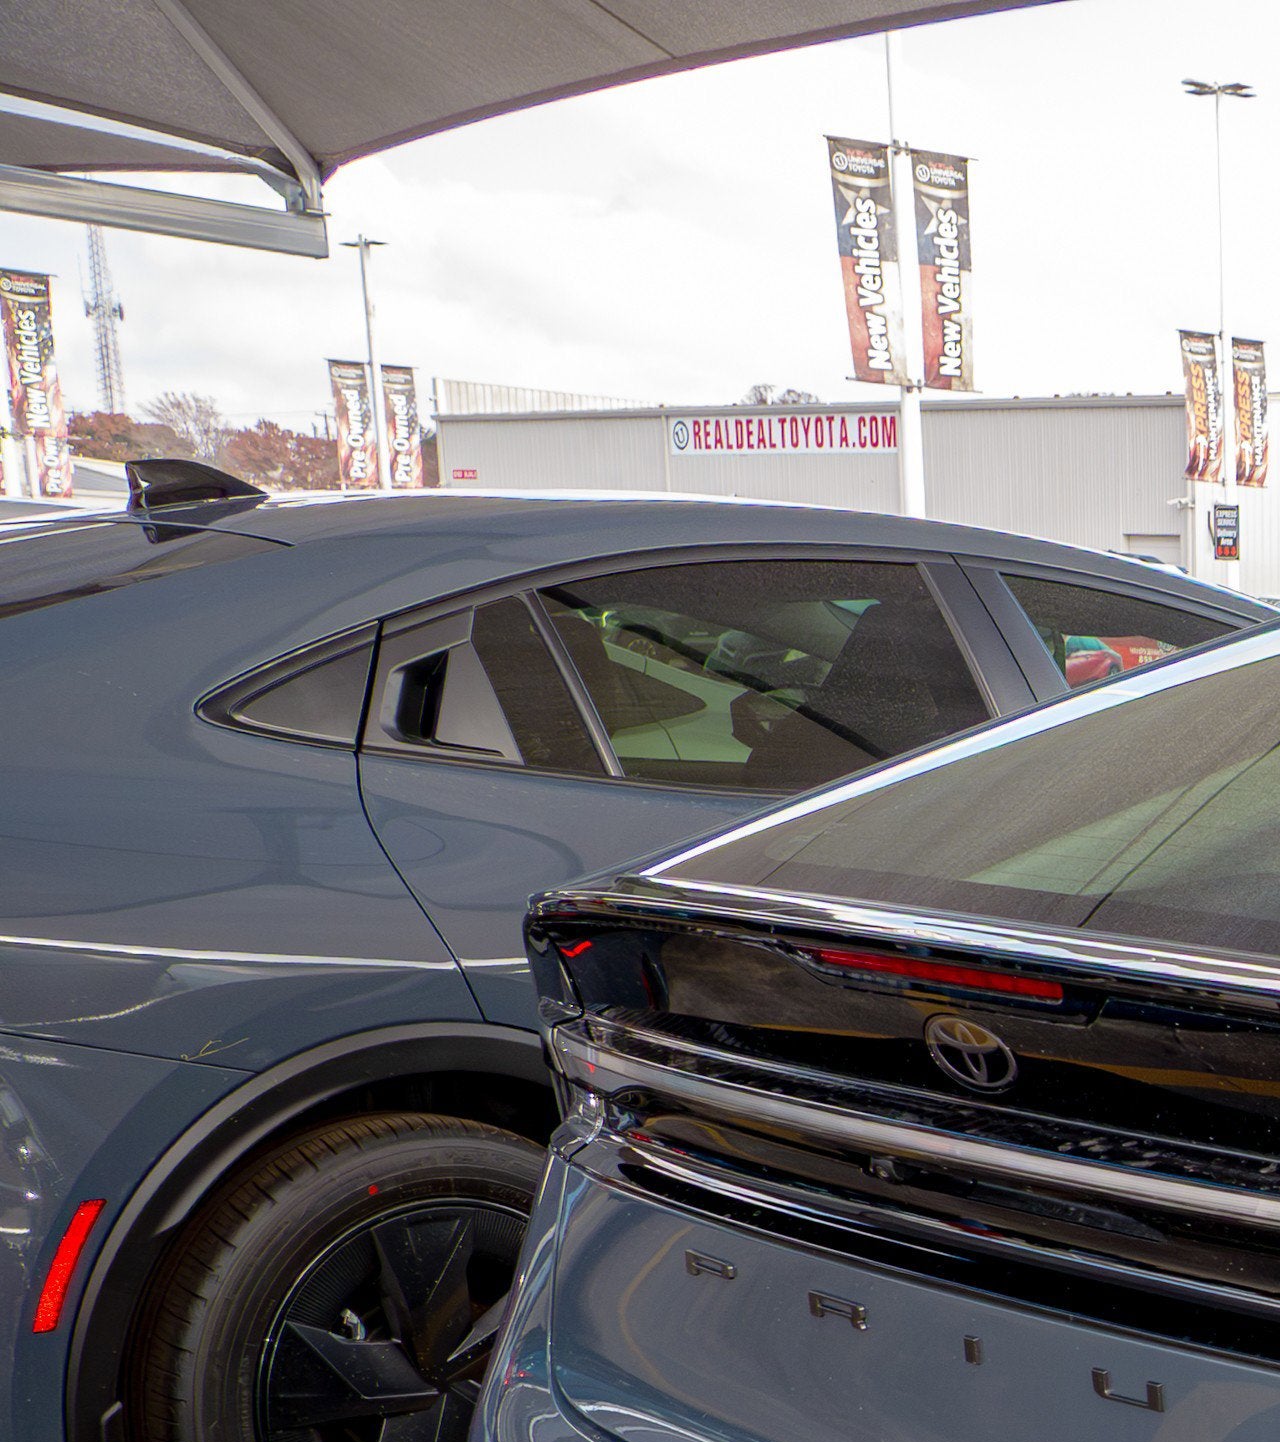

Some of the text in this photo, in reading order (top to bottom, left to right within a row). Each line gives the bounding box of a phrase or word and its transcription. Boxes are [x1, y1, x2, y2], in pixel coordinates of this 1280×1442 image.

[850, 197, 893, 370] New Vehicles
[933, 208, 962, 377] New Vehicles
[15, 309, 44, 385] Vehicles
[26, 386, 50, 428] New
[341, 388, 365, 448] Owned
[388, 394, 410, 451] Owned
[692, 415, 897, 450] REALDEALTOYOTA.COM
[350, 450, 367, 478] Pre
[395, 454, 412, 482] Pre
